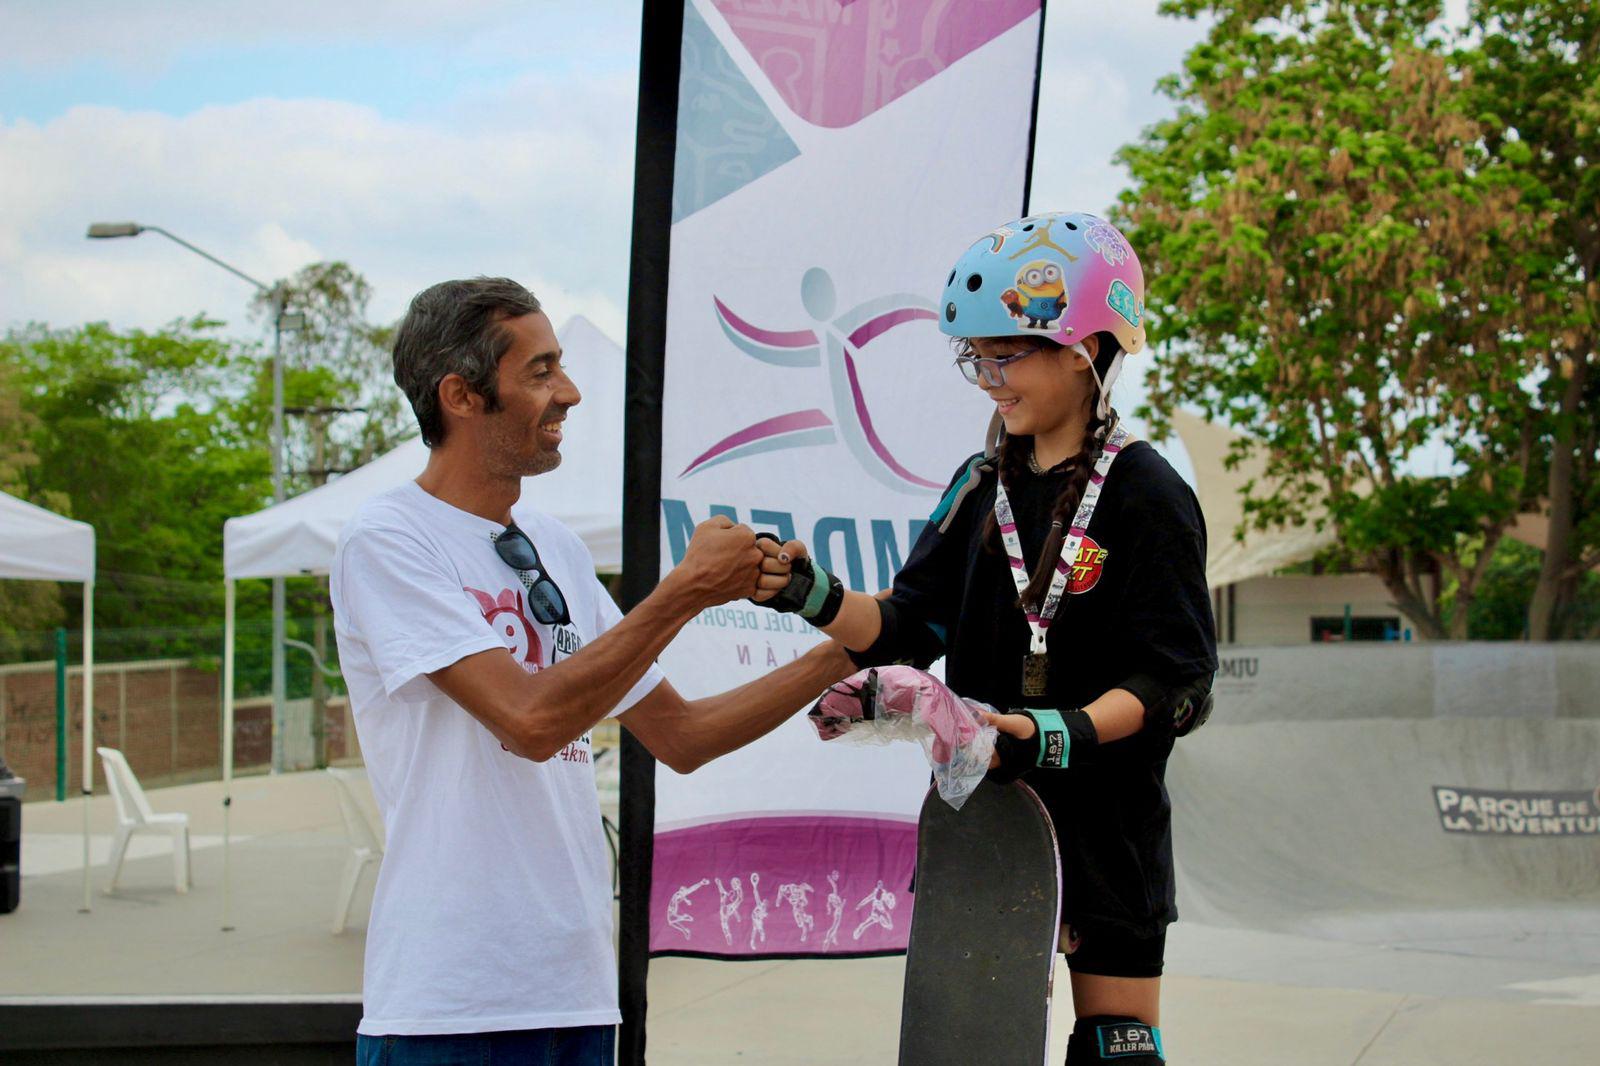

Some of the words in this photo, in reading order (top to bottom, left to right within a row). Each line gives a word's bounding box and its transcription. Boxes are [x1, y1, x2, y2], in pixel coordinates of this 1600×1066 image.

[1047, 735, 1057, 762] 187
[1437, 789, 1554, 818] PARQUE
[1559, 801, 1589, 816] DE
[1443, 815, 1473, 831] LA
[1475, 813, 1600, 834] JUVENTU
[1113, 1029, 1150, 1043] 187
[1110, 1043, 1137, 1053] KILLER
